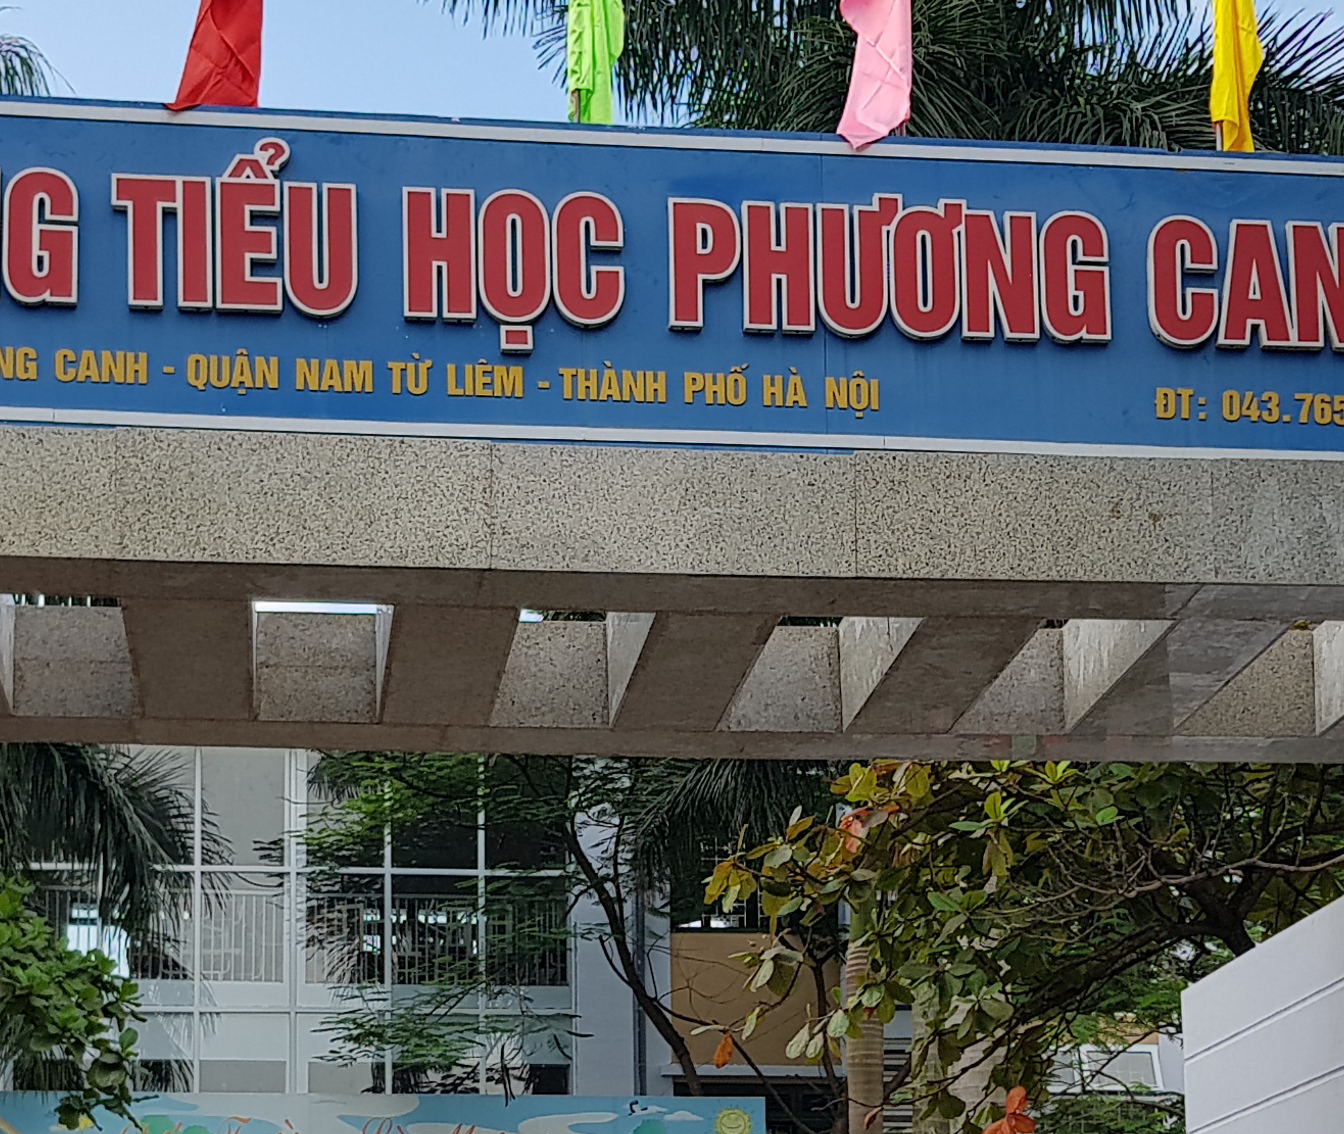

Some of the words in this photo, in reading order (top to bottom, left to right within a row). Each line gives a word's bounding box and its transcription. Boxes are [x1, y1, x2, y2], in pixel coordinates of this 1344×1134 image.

[111, 136, 359, 320] TIỂU
[402, 186, 626, 354] HỌC
[668, 193, 1112, 345] PHƯƠNG
[55, 349, 149, 386] CANH
[186, 349, 280, 397] QUẬN
[296, 359, 374, 394] NAM
[388, 352, 432, 396] TỪ
[446, 359, 524, 399] LIÊM
[559, 361, 667, 404] THÀNH
[684, 363, 749, 406] PHỐ
[762, 367, 808, 409] HÀ
[826, 371, 880, 418] NỘI
[1155, 388, 1207, 421] ĐT:
